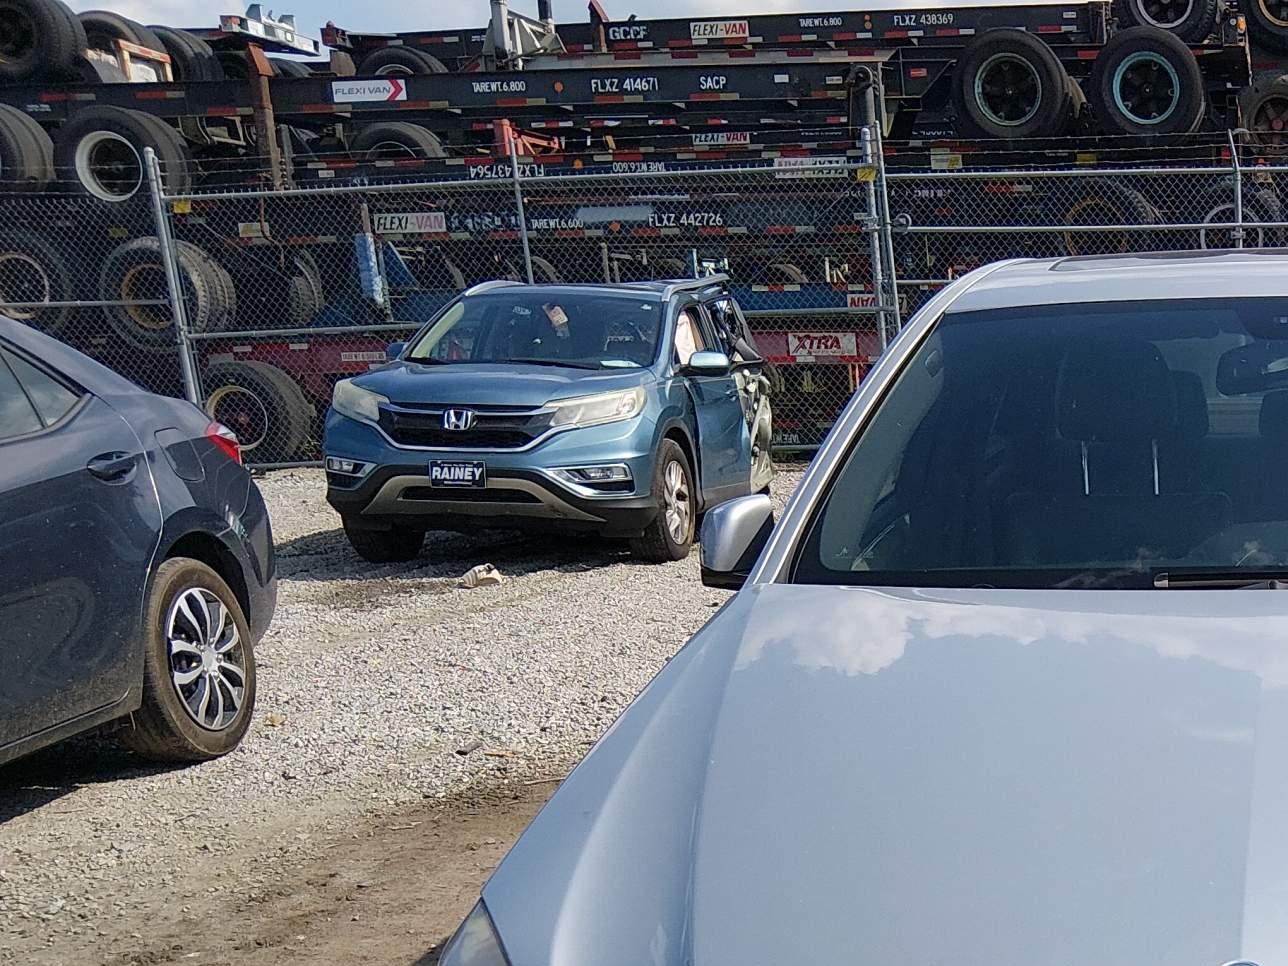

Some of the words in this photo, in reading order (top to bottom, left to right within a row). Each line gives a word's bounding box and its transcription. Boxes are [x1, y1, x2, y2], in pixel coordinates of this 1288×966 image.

[894, 15, 916, 26] FLXZ
[920, 13, 954, 25] 438369
[692, 22, 747, 36] FLEXI-VAN
[591, 79, 619, 92] FLXZ
[623, 77, 659, 91] 414671
[700, 76, 727, 90] SACP
[469, 164, 512, 179] 437564
[518, 163, 545, 178] FLXZ
[376, 215, 445, 231] FLEXI-VAN
[649, 213, 676, 227] FLXZ
[680, 213, 723, 227] 442726
[431, 466, 483, 481] RAINEY
